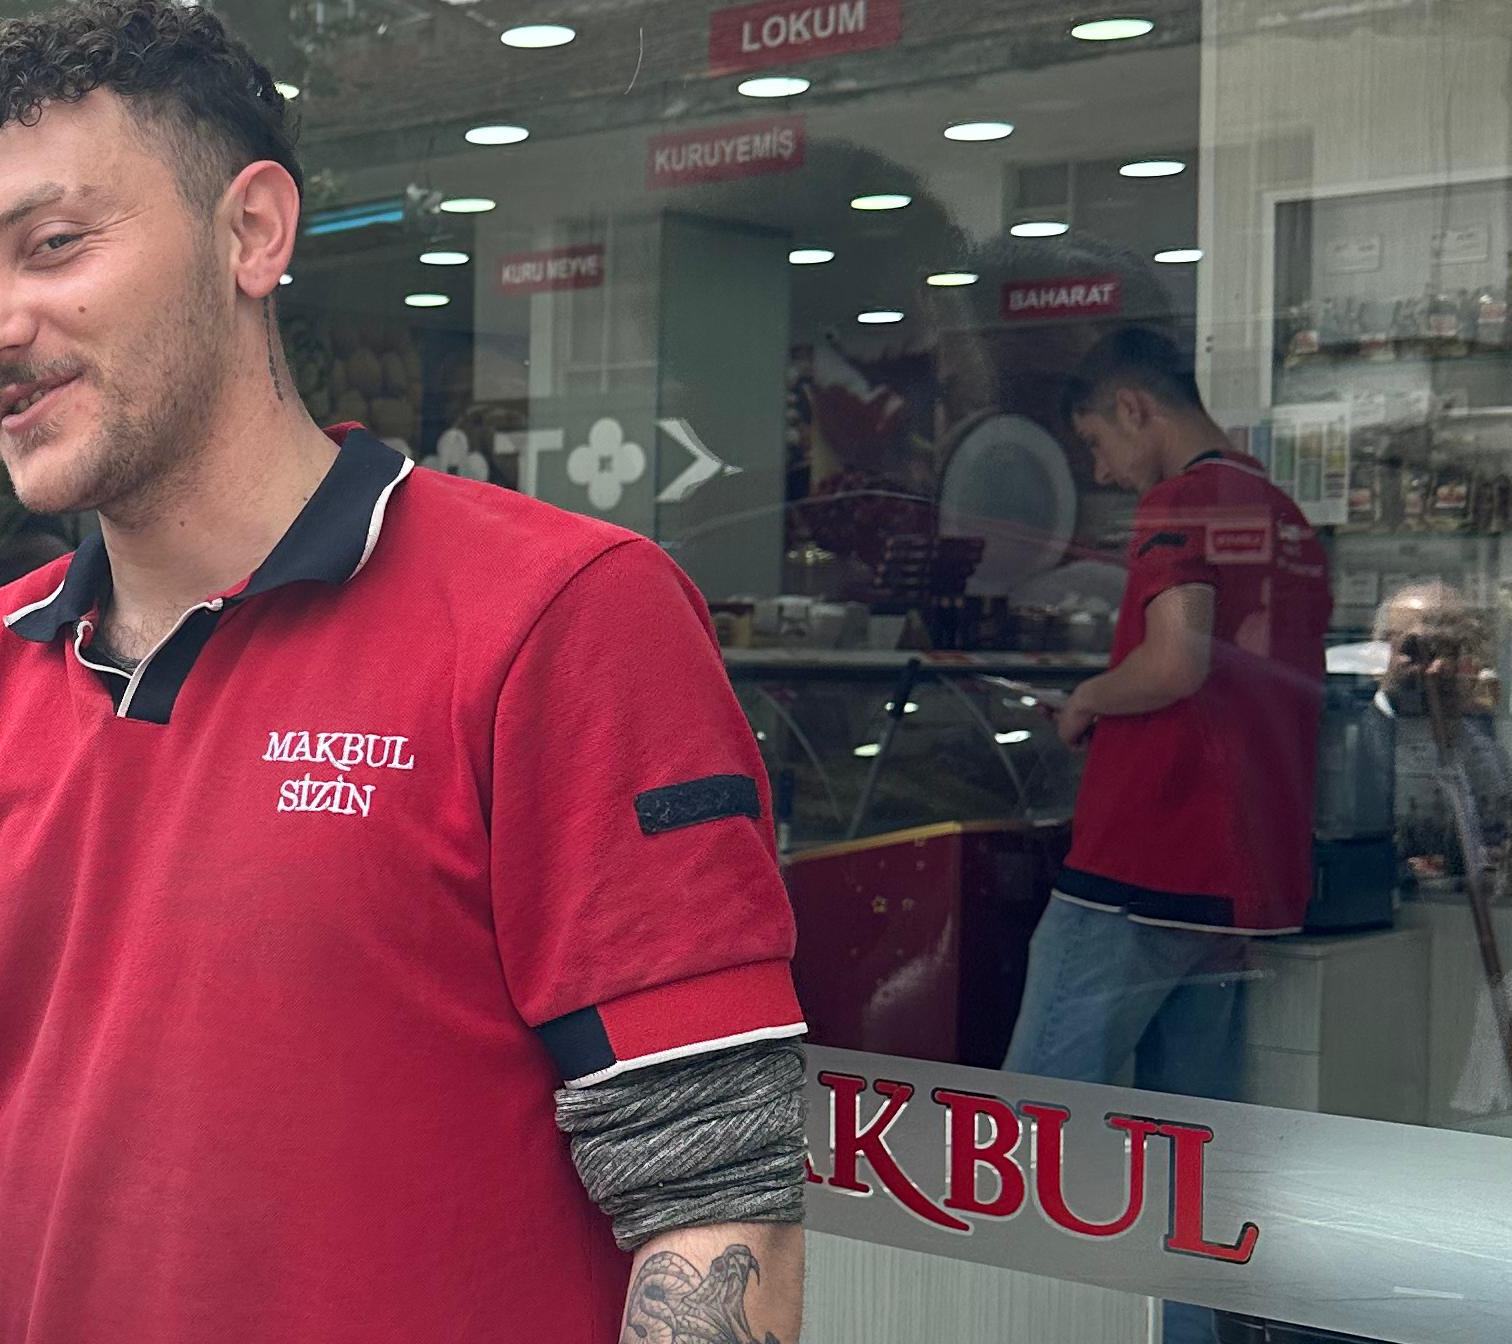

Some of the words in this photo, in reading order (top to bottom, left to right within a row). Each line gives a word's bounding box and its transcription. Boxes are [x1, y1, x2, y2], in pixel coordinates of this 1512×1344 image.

[741, 0, 867, 53] LOKUM
[653, 126, 795, 175] KURUYEMİŞ
[502, 261, 543, 285] KURU
[1008, 282, 1117, 312] BAHARAT
[261, 730, 416, 772] MAKBUL
[276, 772, 377, 818] SİZİN
[806, 1070, 1260, 1265] KBUL
